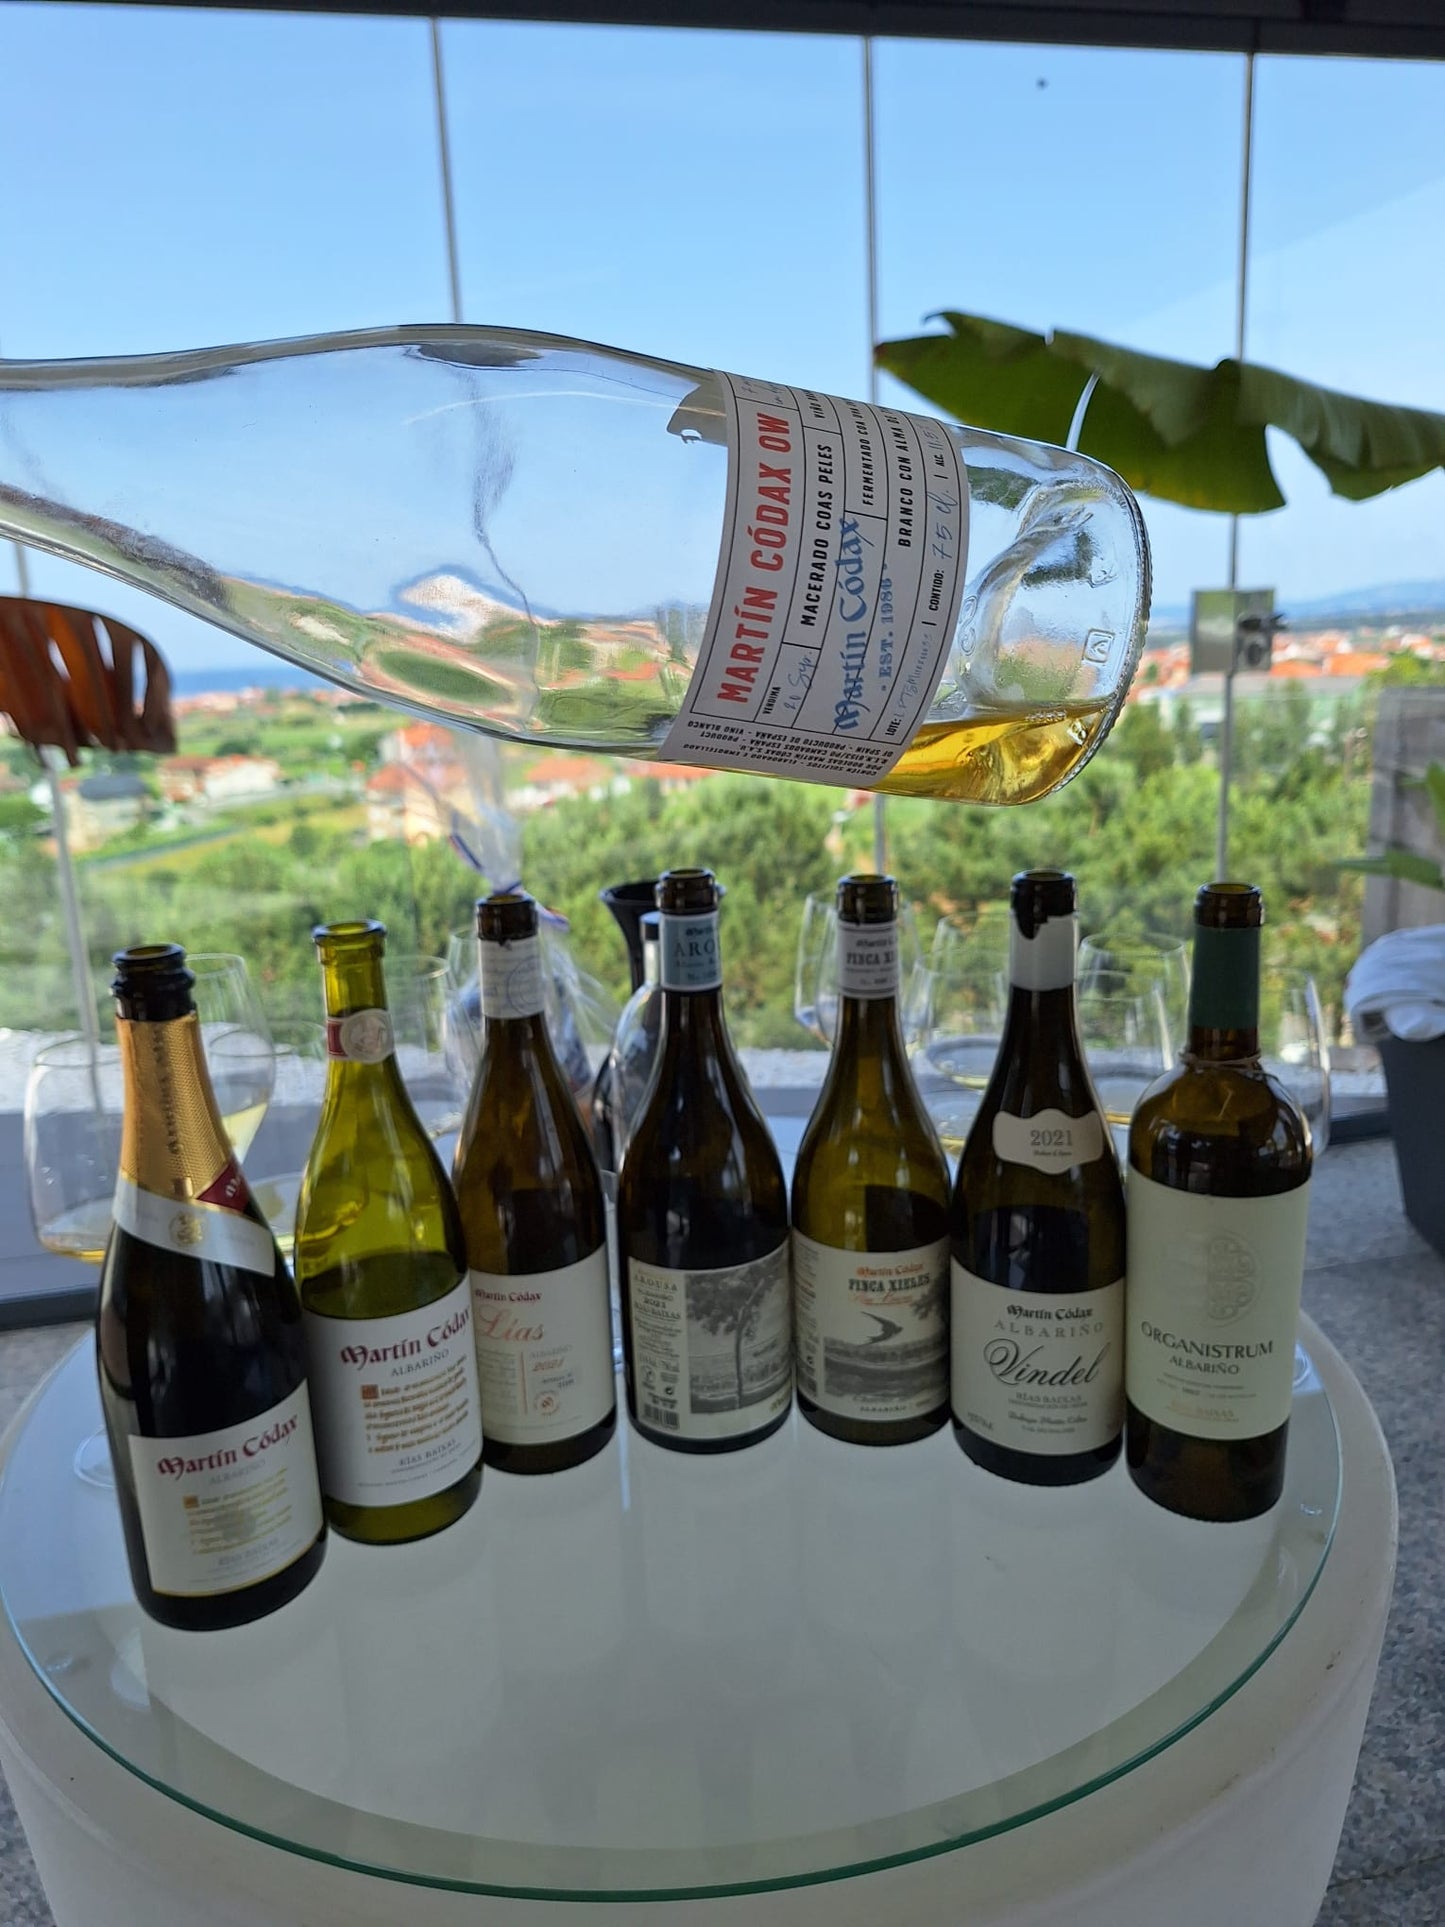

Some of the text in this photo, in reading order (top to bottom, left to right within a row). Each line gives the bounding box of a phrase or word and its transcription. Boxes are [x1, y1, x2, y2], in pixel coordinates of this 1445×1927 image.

[756, 412, 792, 453] OW
[890, 426, 909, 452] ALMA
[860, 438, 874, 506] FERMENTADO
[897, 456, 913, 481] CON
[747, 462, 792, 572] CÓDAX
[800, 444, 834, 627] MACERADO COAS PELES
[898, 487, 914, 548] BRANCO
[928, 569, 945, 612] CONTIDO:
[834, 517, 875, 730] Martín Códax
[878, 577, 894, 678] EST. 1986
[717, 586, 778, 703] MARTÍN
[762, 686, 782, 715] VENDIMA
[885, 718, 902, 737] LOTE:
[1029, 1129, 1074, 1147] 2021
[1006, 1303, 1094, 1322] Martín Códax
[340, 1338, 422, 1371] Martín
[1140, 1320, 1274, 1360] ORGANISTRUM
[983, 1338, 1112, 1387] Vindel
[1169, 1355, 1240, 1376] ALBARIÑO
[157, 1448, 239, 1482] Martín
